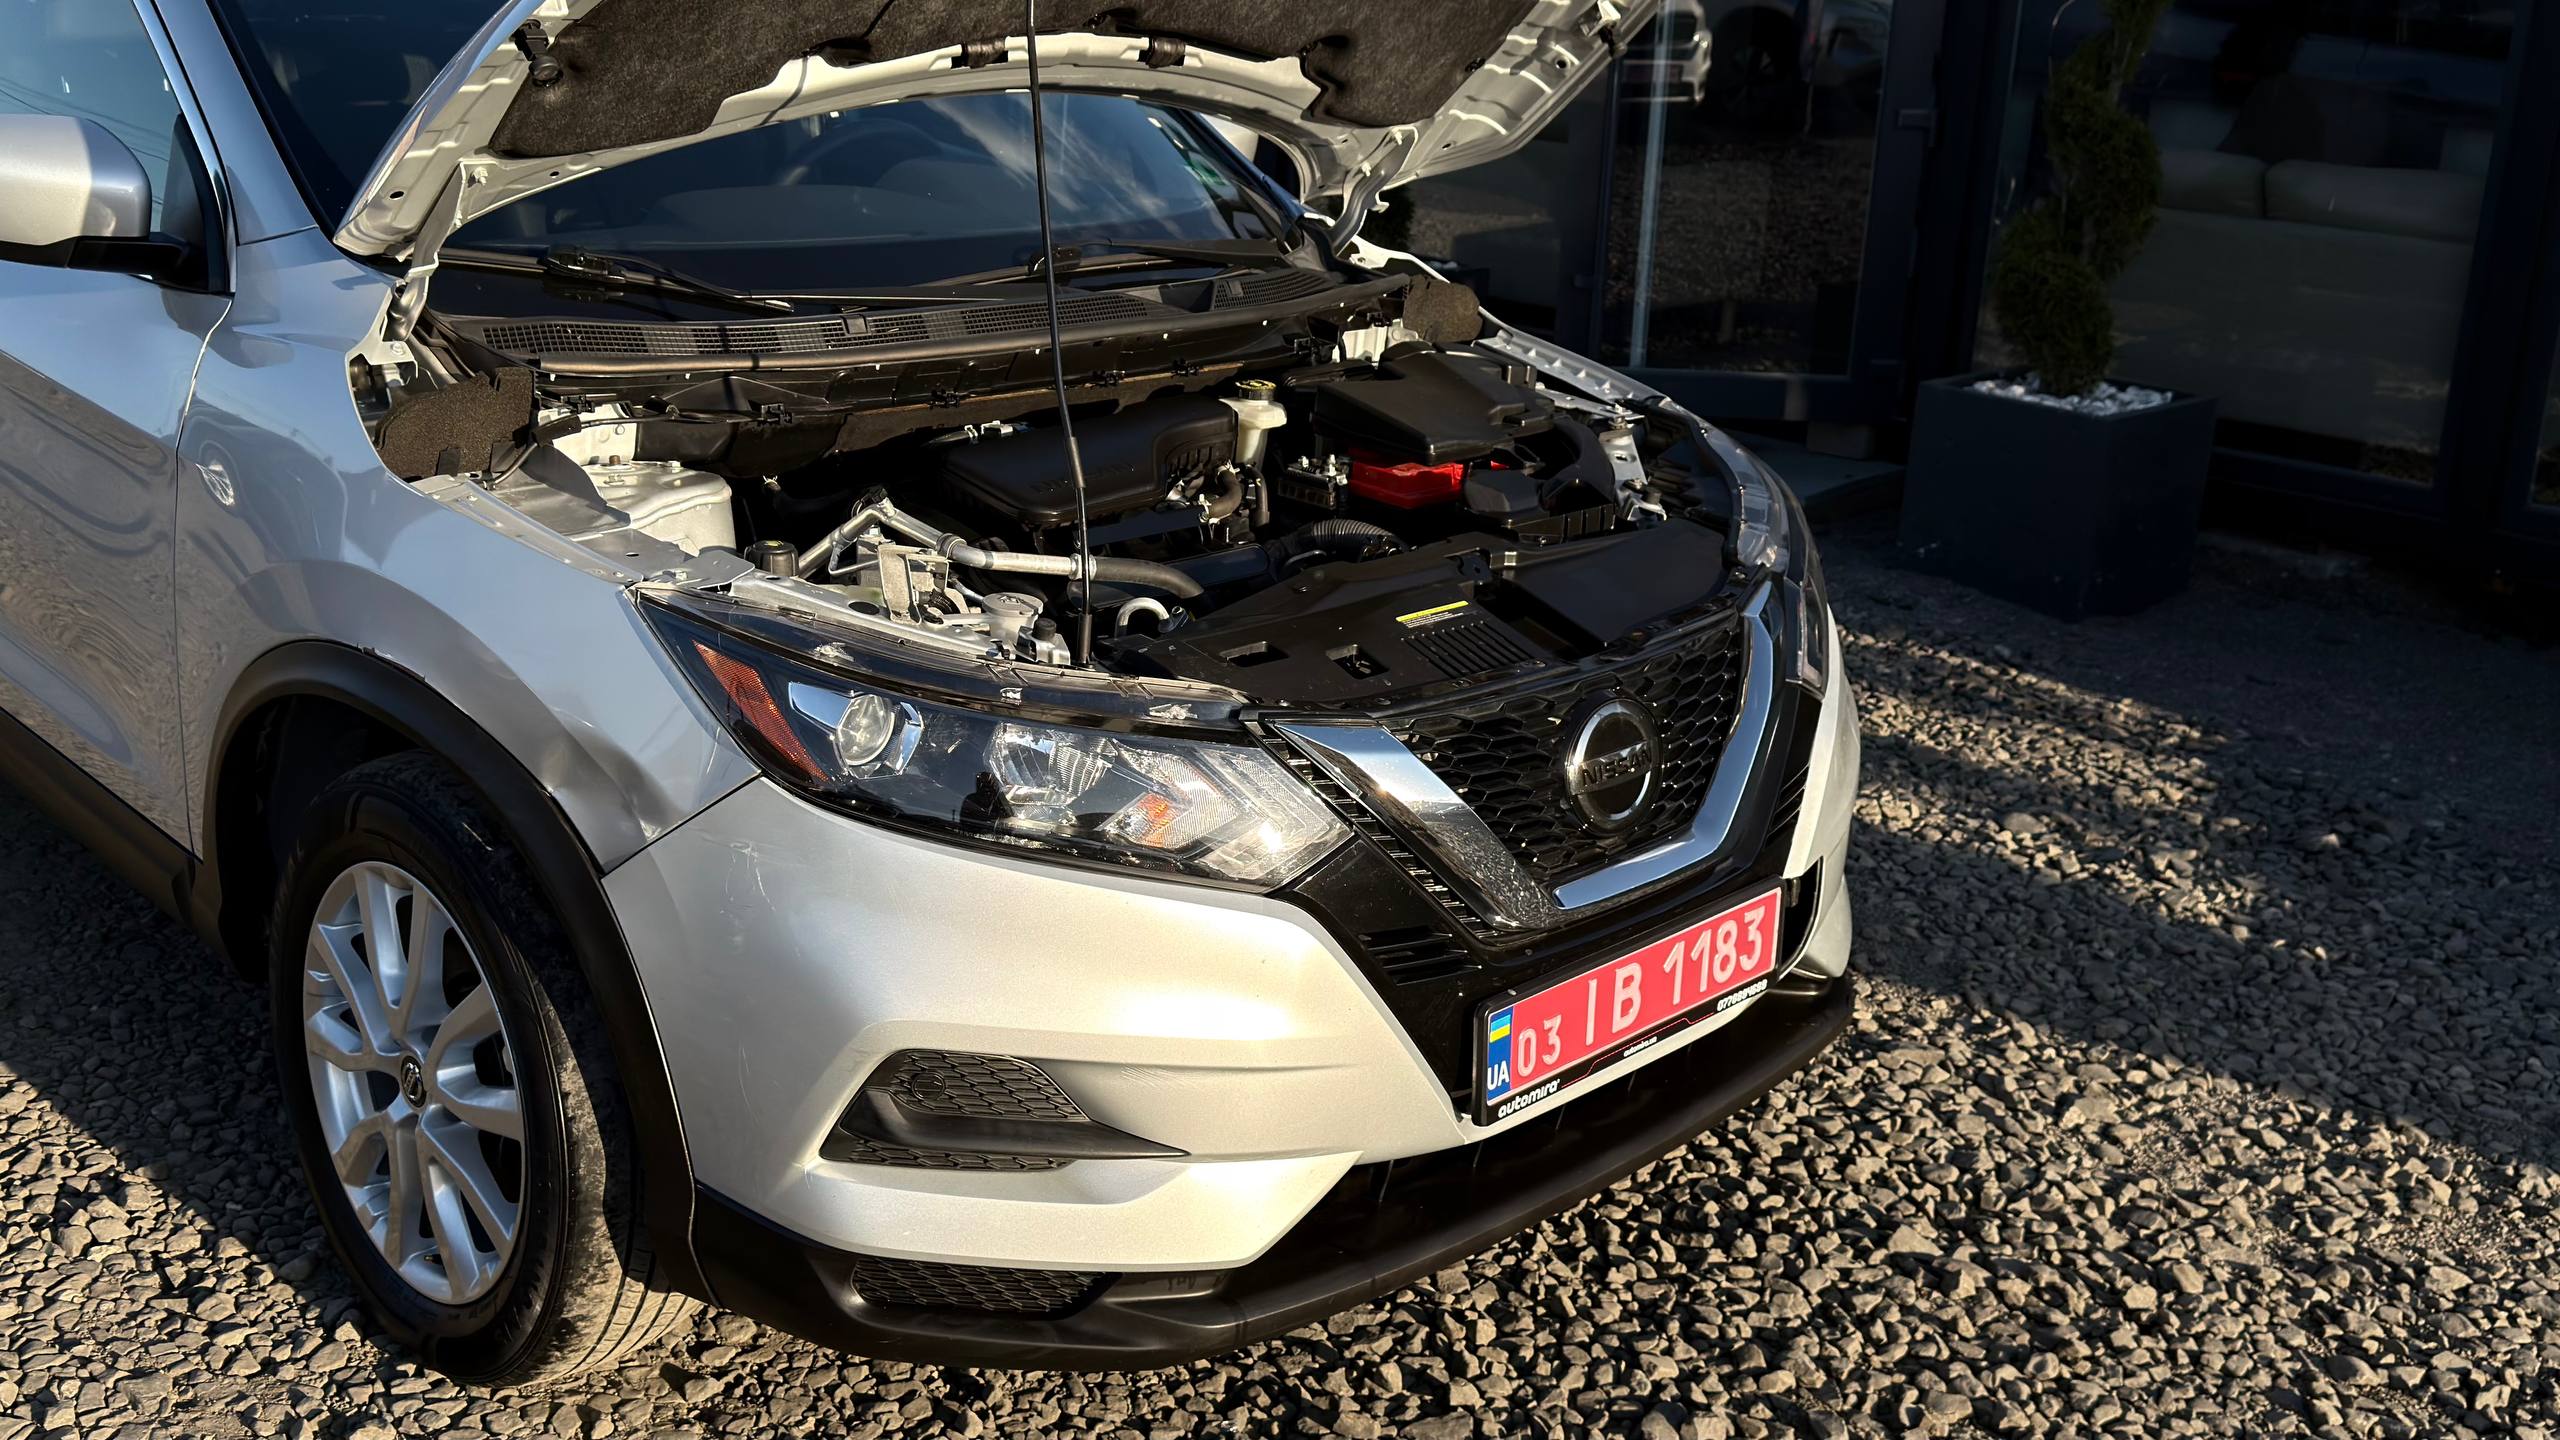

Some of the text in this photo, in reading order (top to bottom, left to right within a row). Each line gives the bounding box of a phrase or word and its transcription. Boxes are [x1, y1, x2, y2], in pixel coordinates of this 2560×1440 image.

[1518, 1014, 1562, 1078] 03
[1664, 905, 1766, 1006] 1183
[1487, 1061, 1510, 1091] UA
[1498, 1080, 1558, 1118] automira
